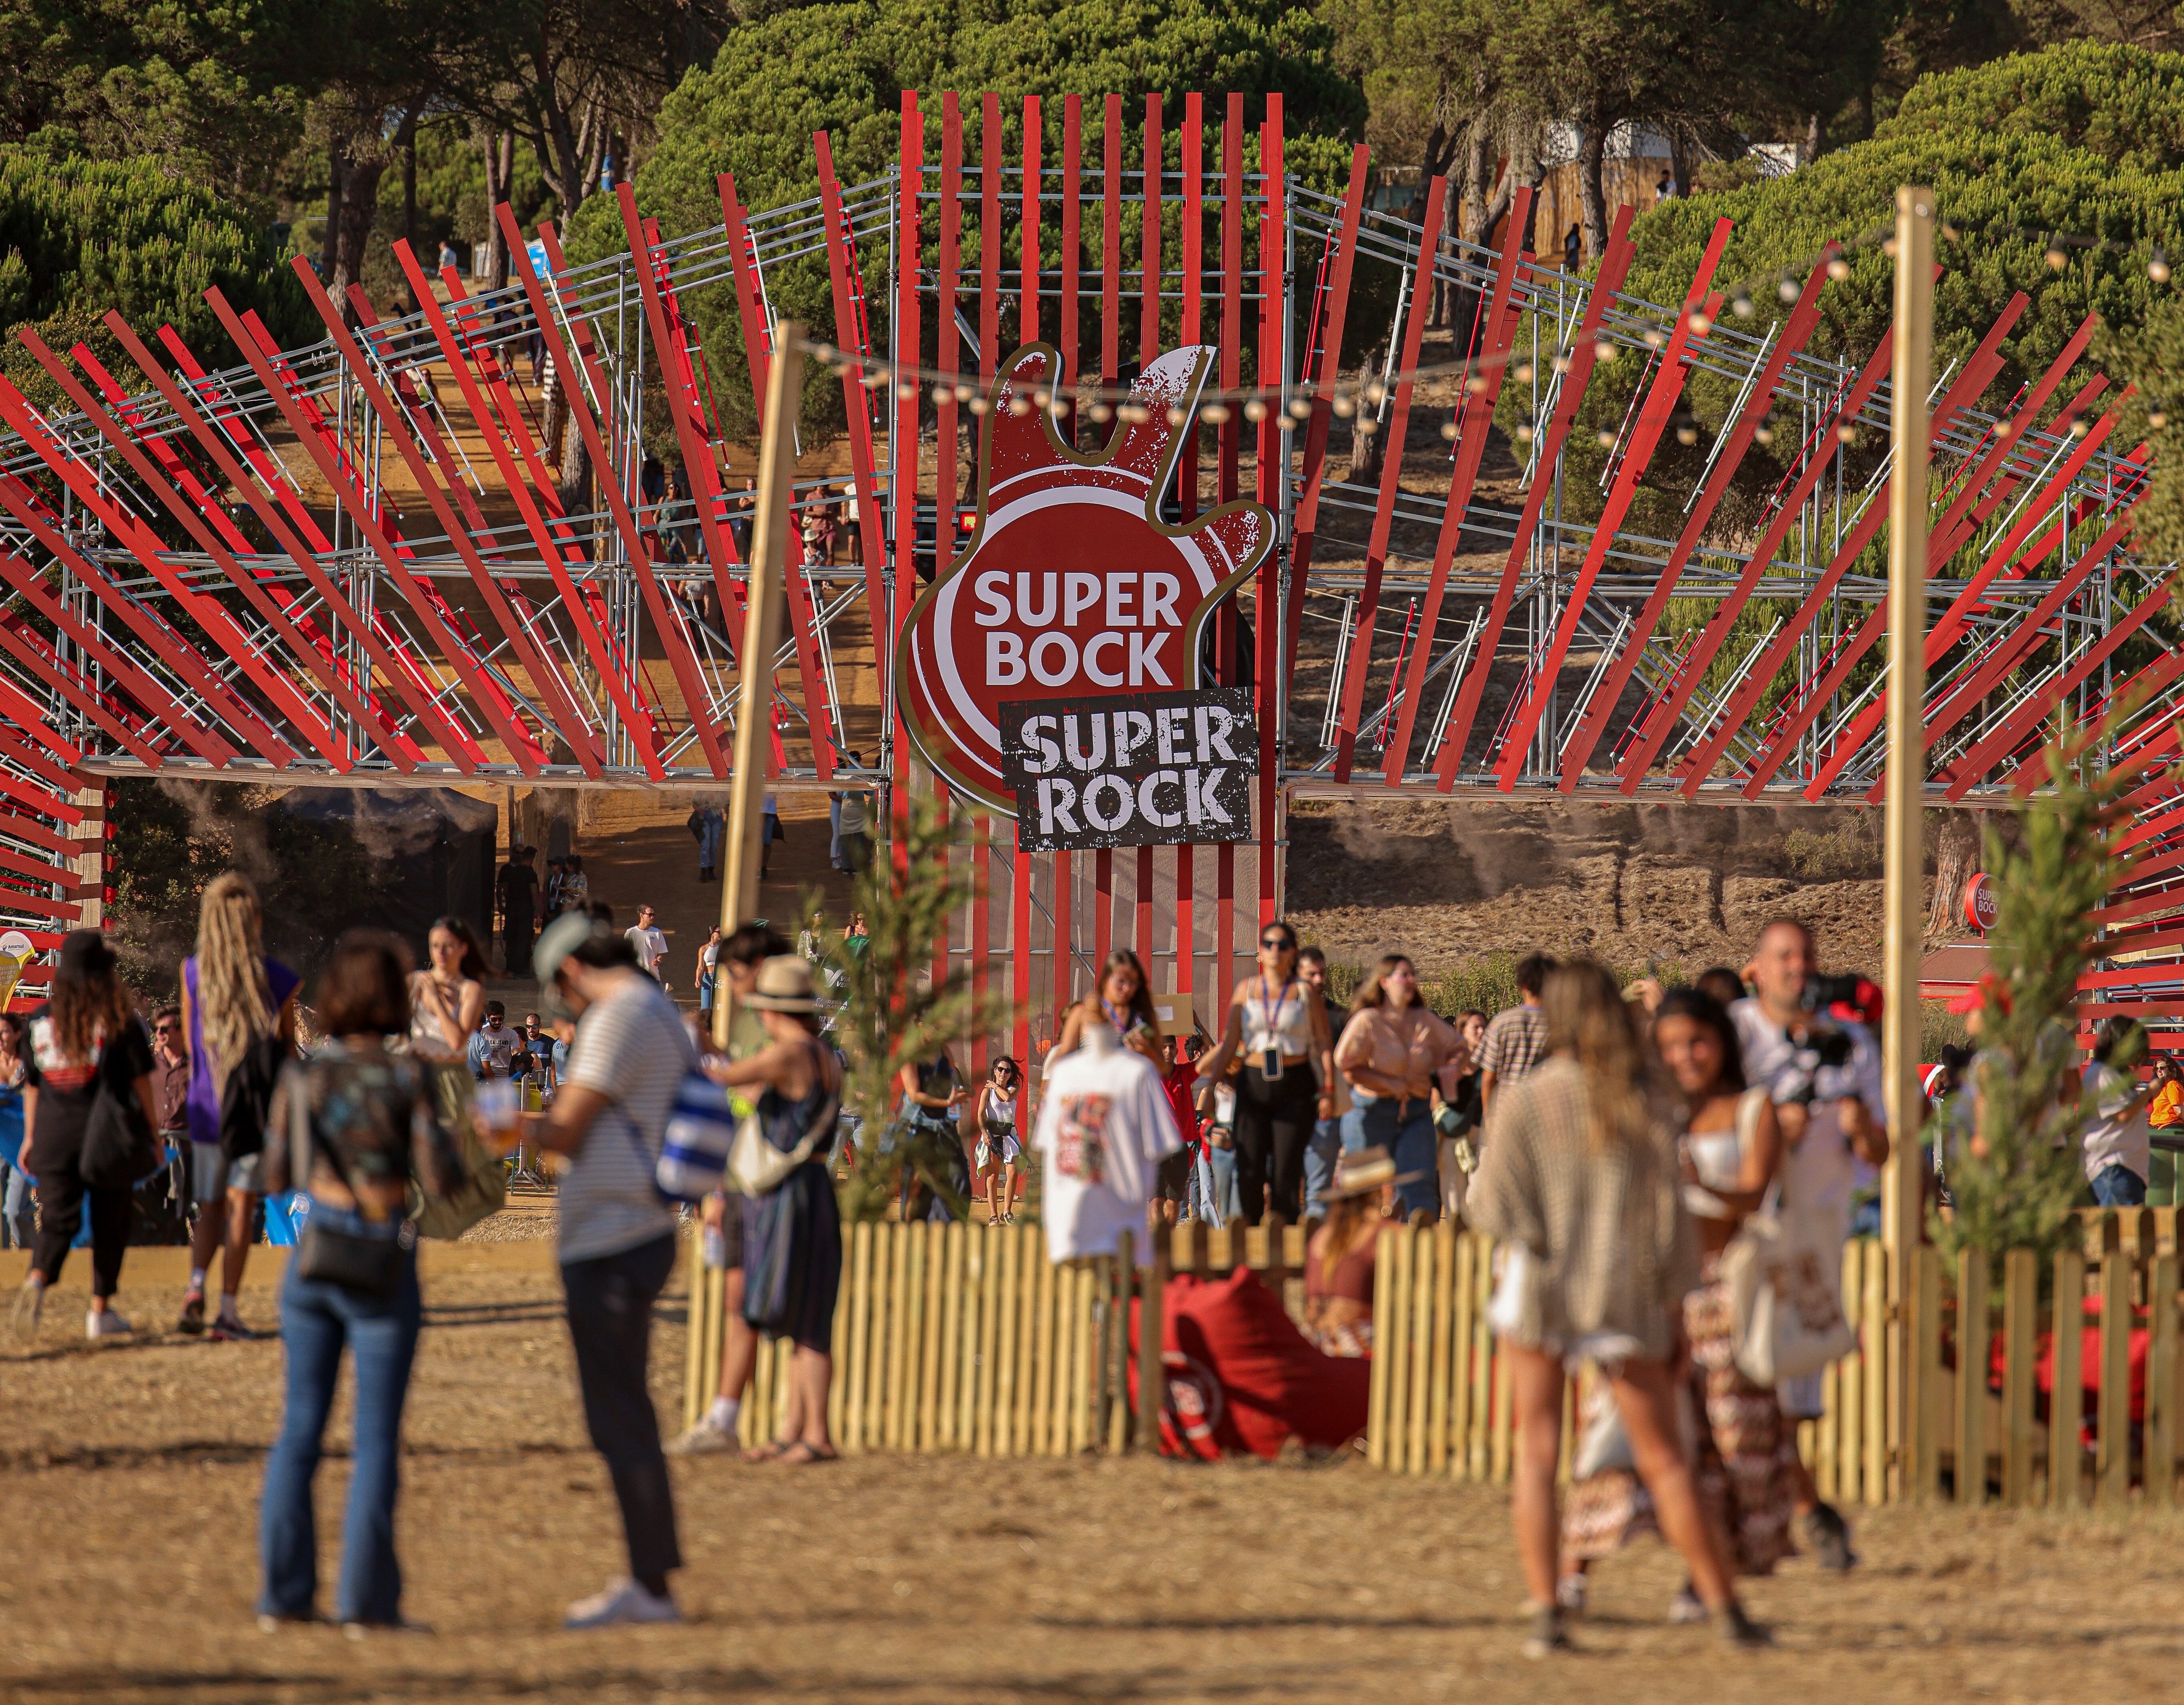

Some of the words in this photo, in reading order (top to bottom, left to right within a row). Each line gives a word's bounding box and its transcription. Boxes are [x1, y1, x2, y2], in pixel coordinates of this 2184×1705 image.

[975, 571, 1182, 627] SUPER
[986, 631, 1173, 687] BOCK
[1021, 706, 1238, 773] SUPER
[1037, 768, 1233, 834] ROCK
[1978, 889, 1999, 902] SUPE
[1979, 900, 1998, 914] BOCK
